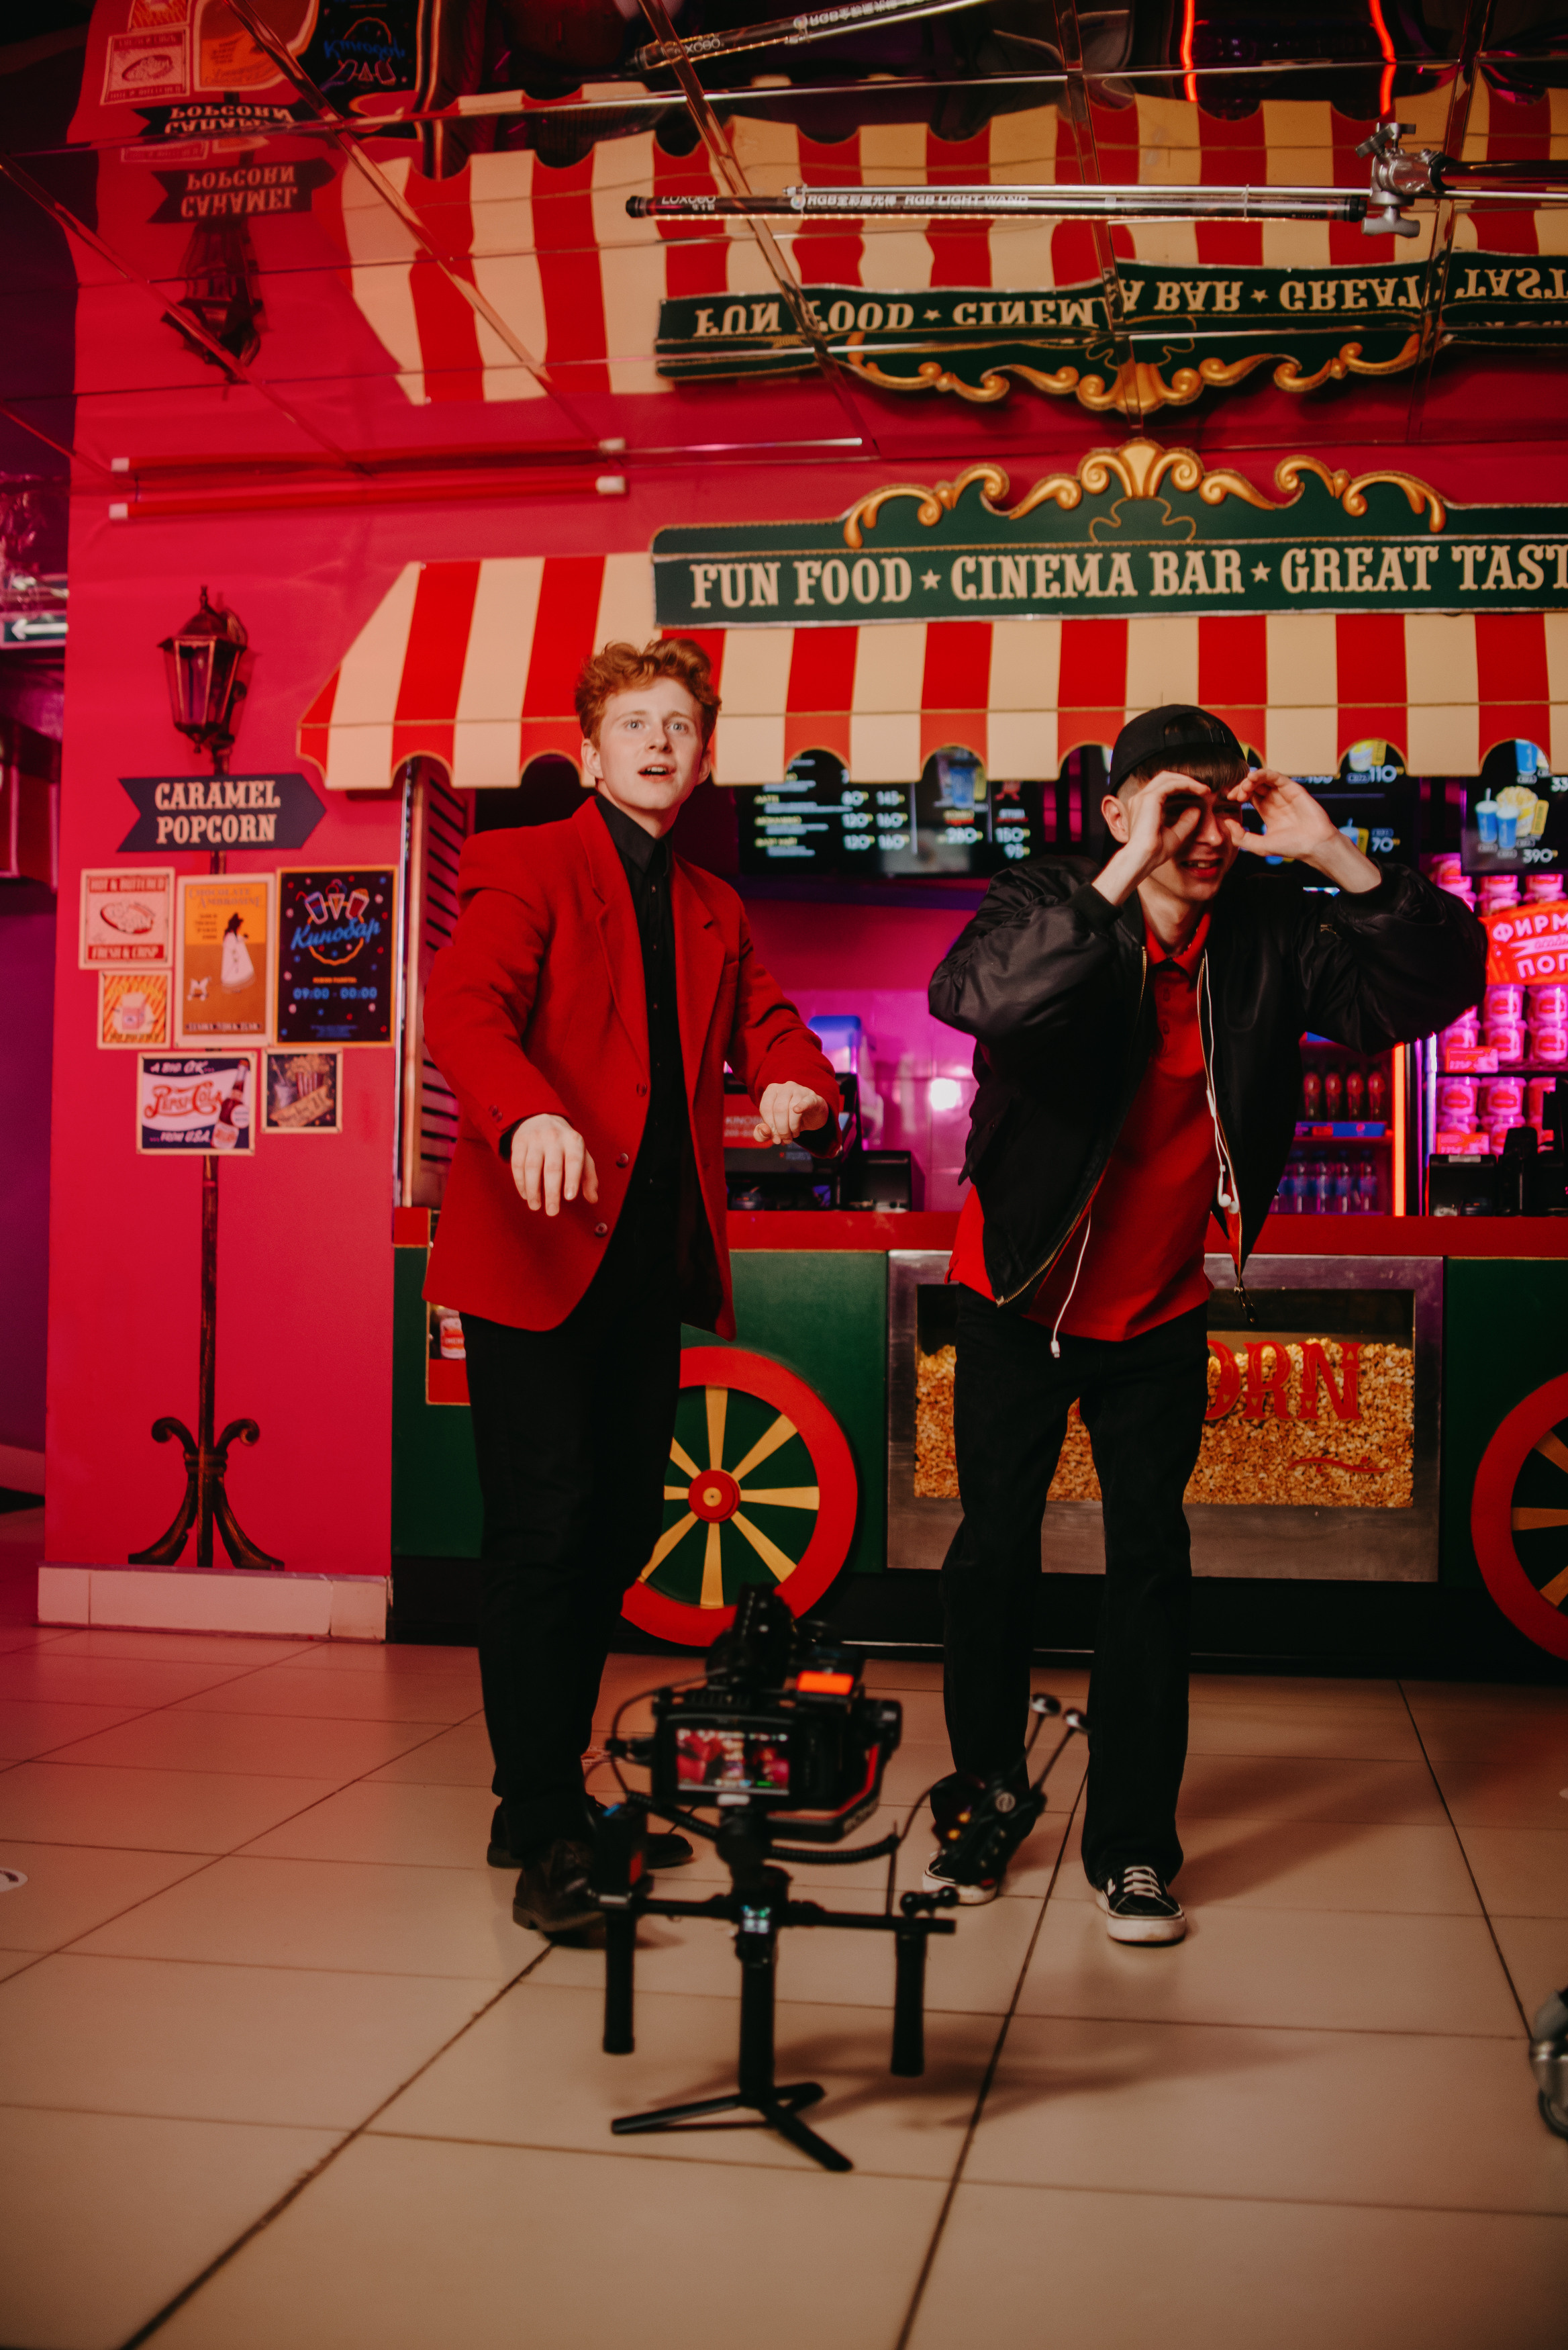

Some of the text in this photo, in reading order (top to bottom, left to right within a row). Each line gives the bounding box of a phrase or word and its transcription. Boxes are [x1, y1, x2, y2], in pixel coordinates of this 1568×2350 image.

[905, 195, 935, 205] RGB
[938, 195, 982, 205] LIGHT
[984, 195, 1029, 206] WAND
[689, 544, 1568, 608] FUN FOOD CINEMA BAR GREAT TAST
[1369, 764, 1398, 783] 110
[154, 780, 281, 811] CARAMEL
[156, 814, 277, 844] POPCORN
[1372, 837, 1394, 853] 70
[1522, 848, 1553, 864] 390
[291, 918, 381, 951] Кинобар
